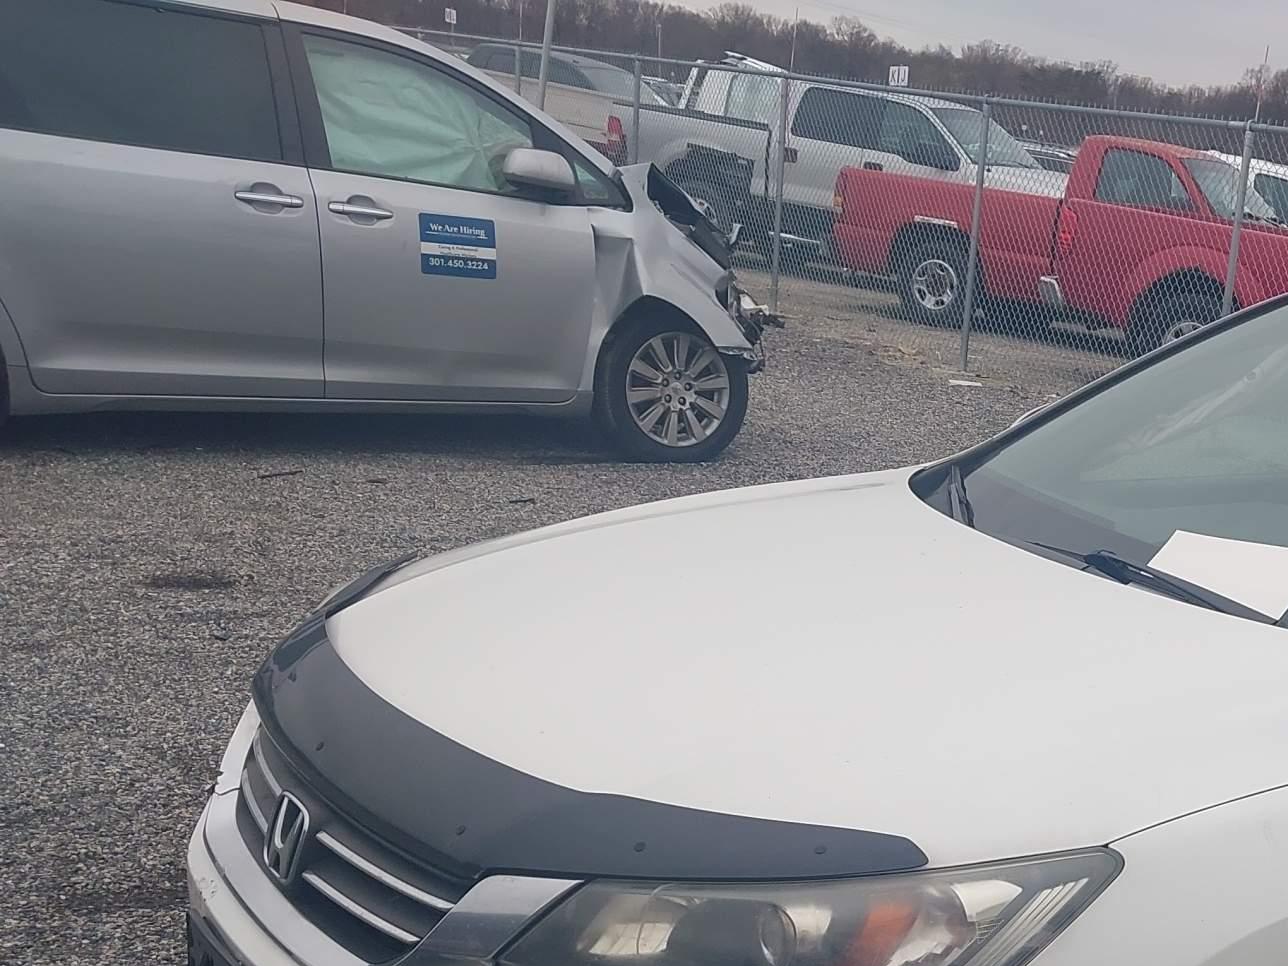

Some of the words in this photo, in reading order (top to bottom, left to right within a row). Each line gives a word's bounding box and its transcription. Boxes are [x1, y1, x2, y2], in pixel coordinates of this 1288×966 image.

[430, 223, 442, 231] We
[444, 224, 459, 233] Are
[460, 226, 485, 237] Hiring
[429, 257, 488, 270] 301.450.3224
